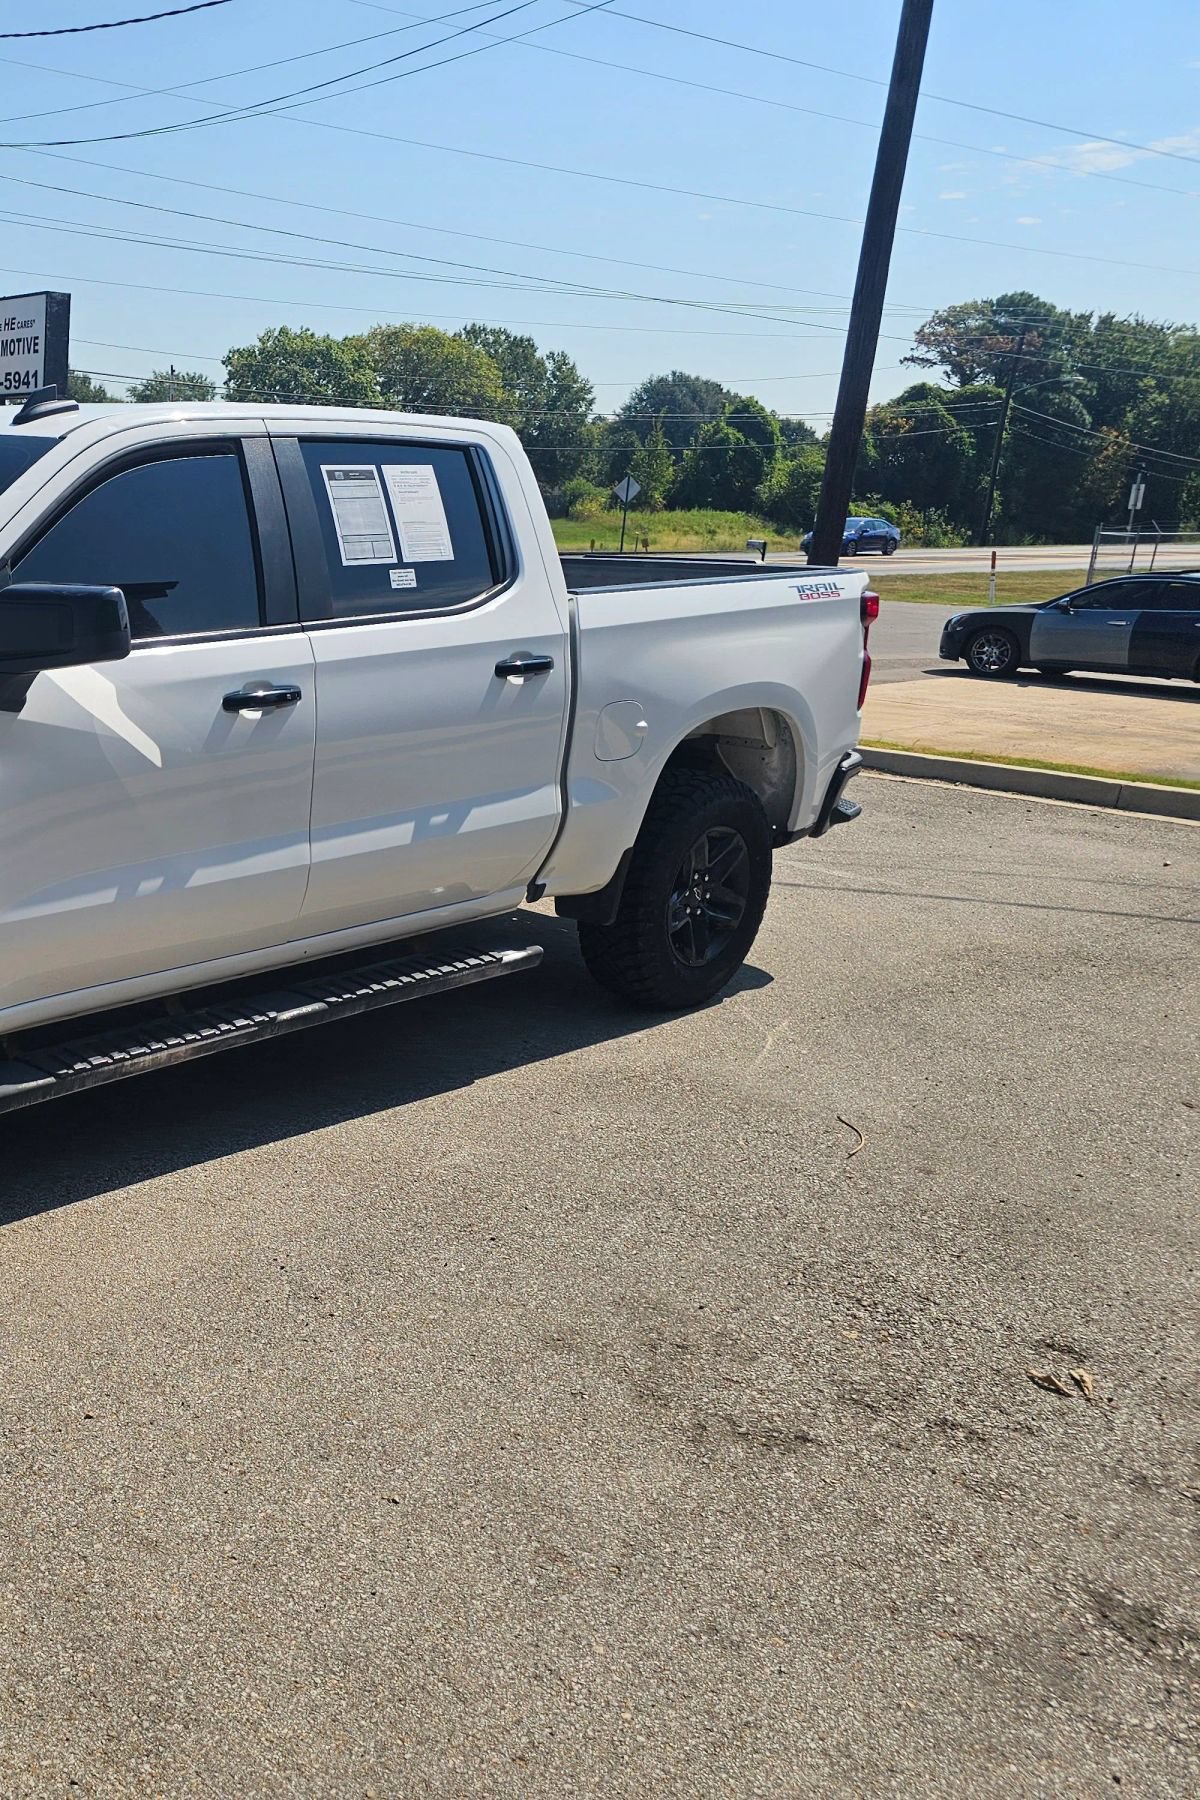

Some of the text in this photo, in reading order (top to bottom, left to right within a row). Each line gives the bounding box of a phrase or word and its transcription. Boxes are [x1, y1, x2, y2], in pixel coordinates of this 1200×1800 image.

[4, 317, 16, 331] HE
[788, 583, 845, 593] TRAIL
[800, 591, 841, 600] BOSS
